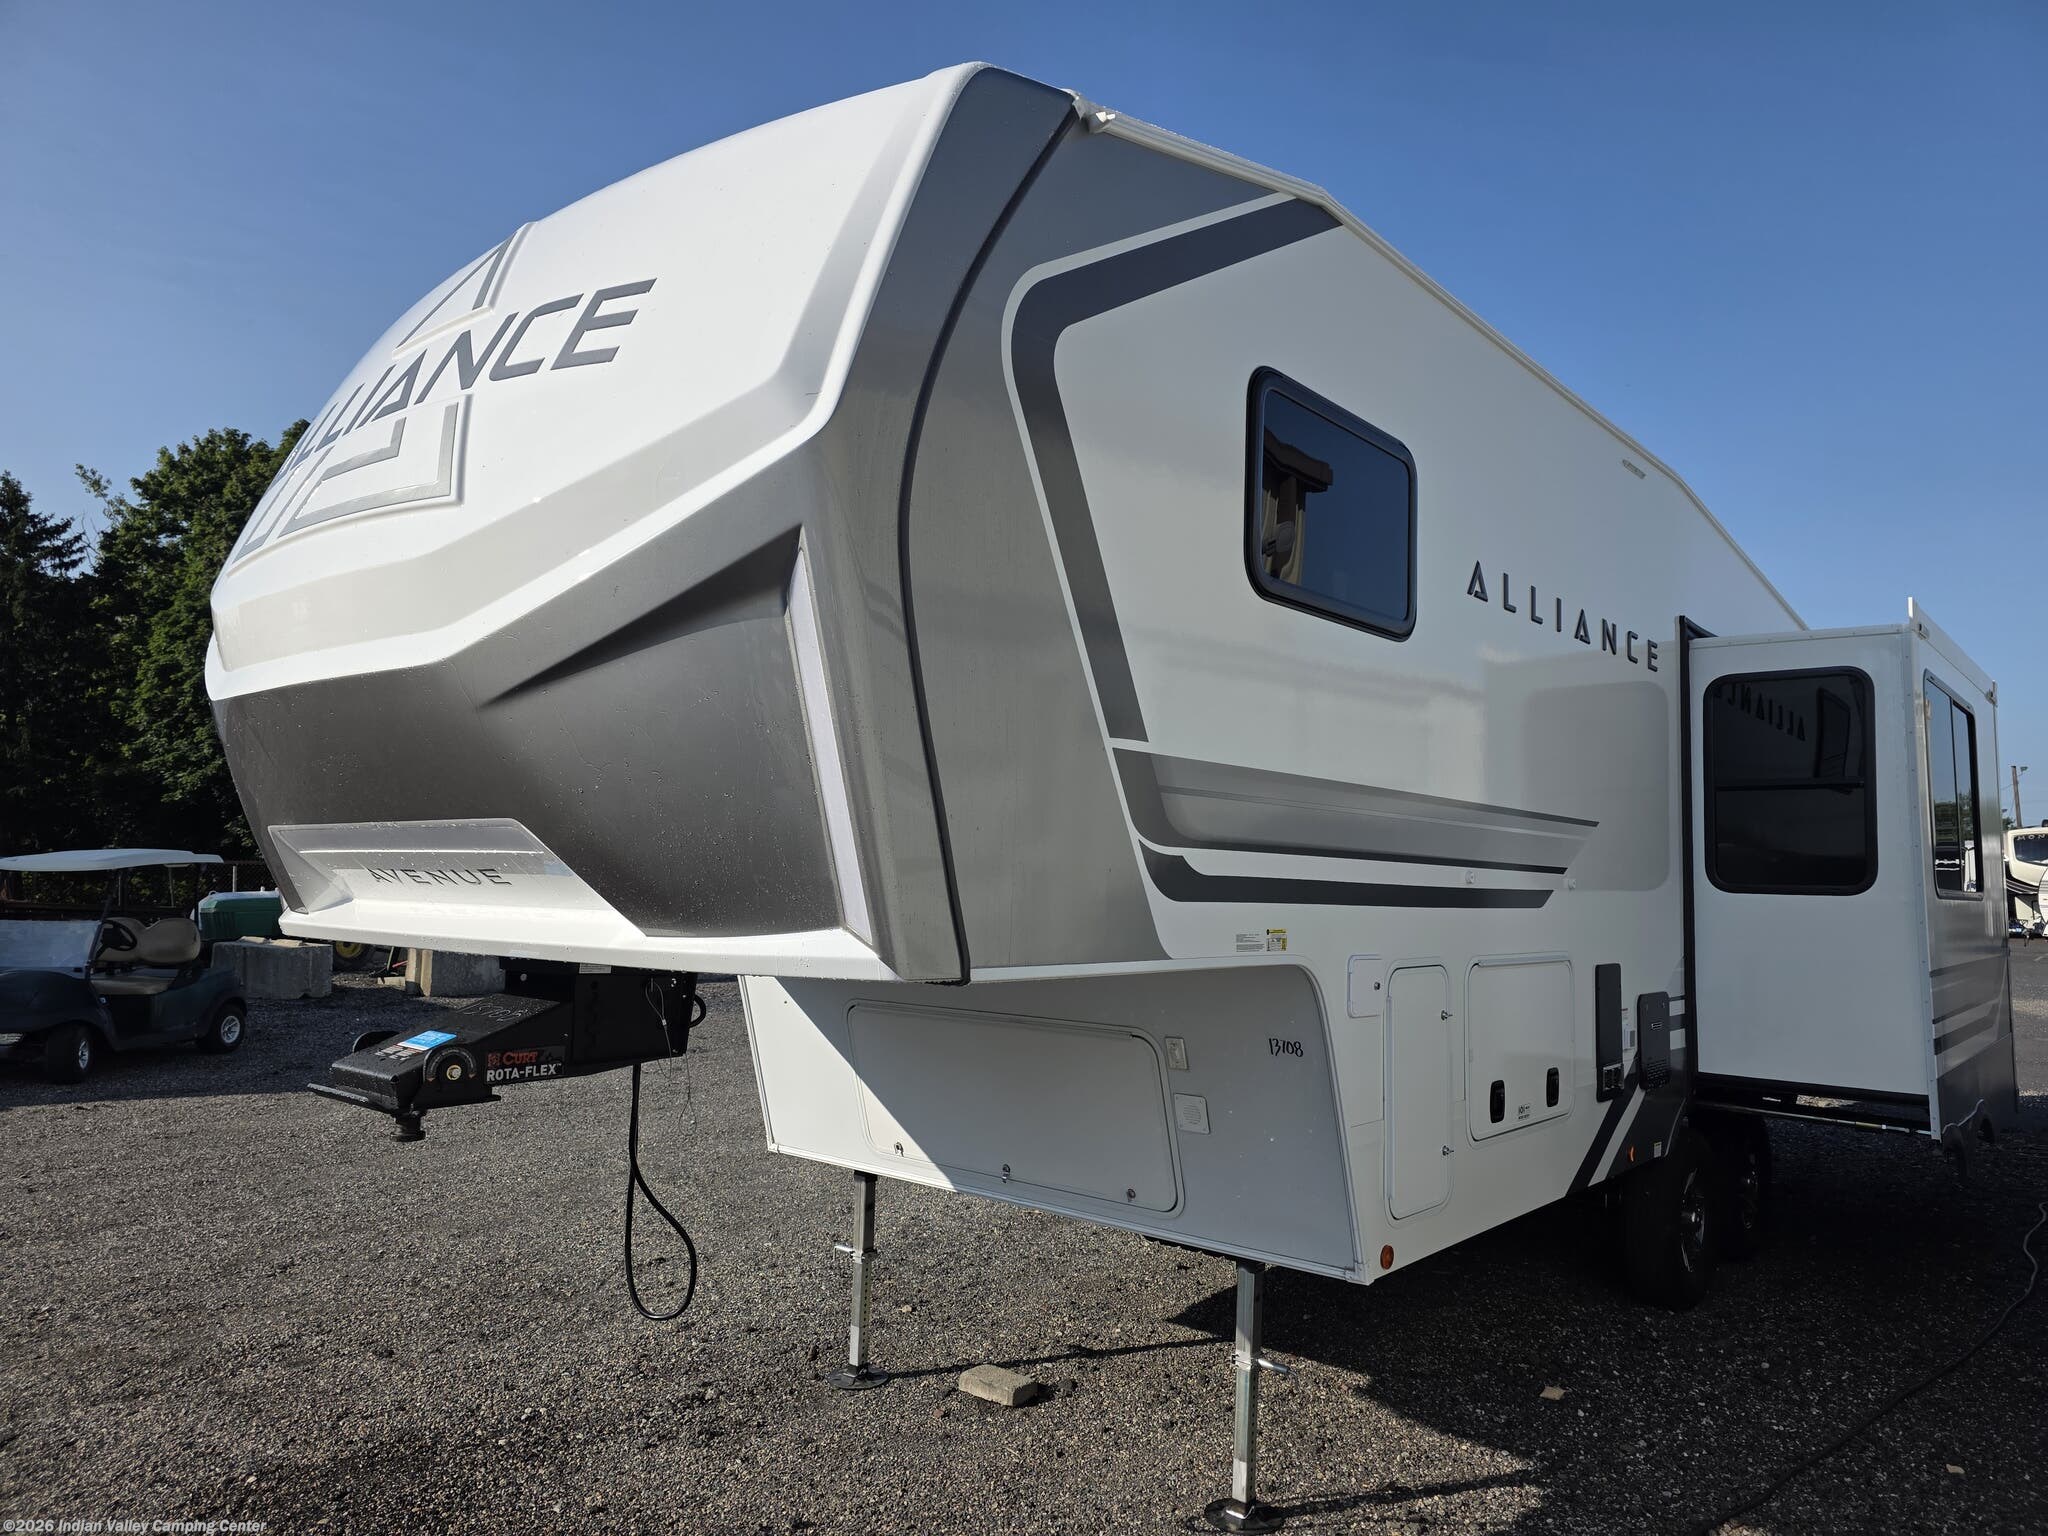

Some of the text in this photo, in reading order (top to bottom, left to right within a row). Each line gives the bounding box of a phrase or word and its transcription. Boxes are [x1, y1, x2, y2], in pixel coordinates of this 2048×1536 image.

[1467, 559, 1658, 672] ALLIANCE
[366, 868, 513, 886] AVENUE
[1268, 1037, 1304, 1058] 13708
[502, 1051, 538, 1065] CURT
